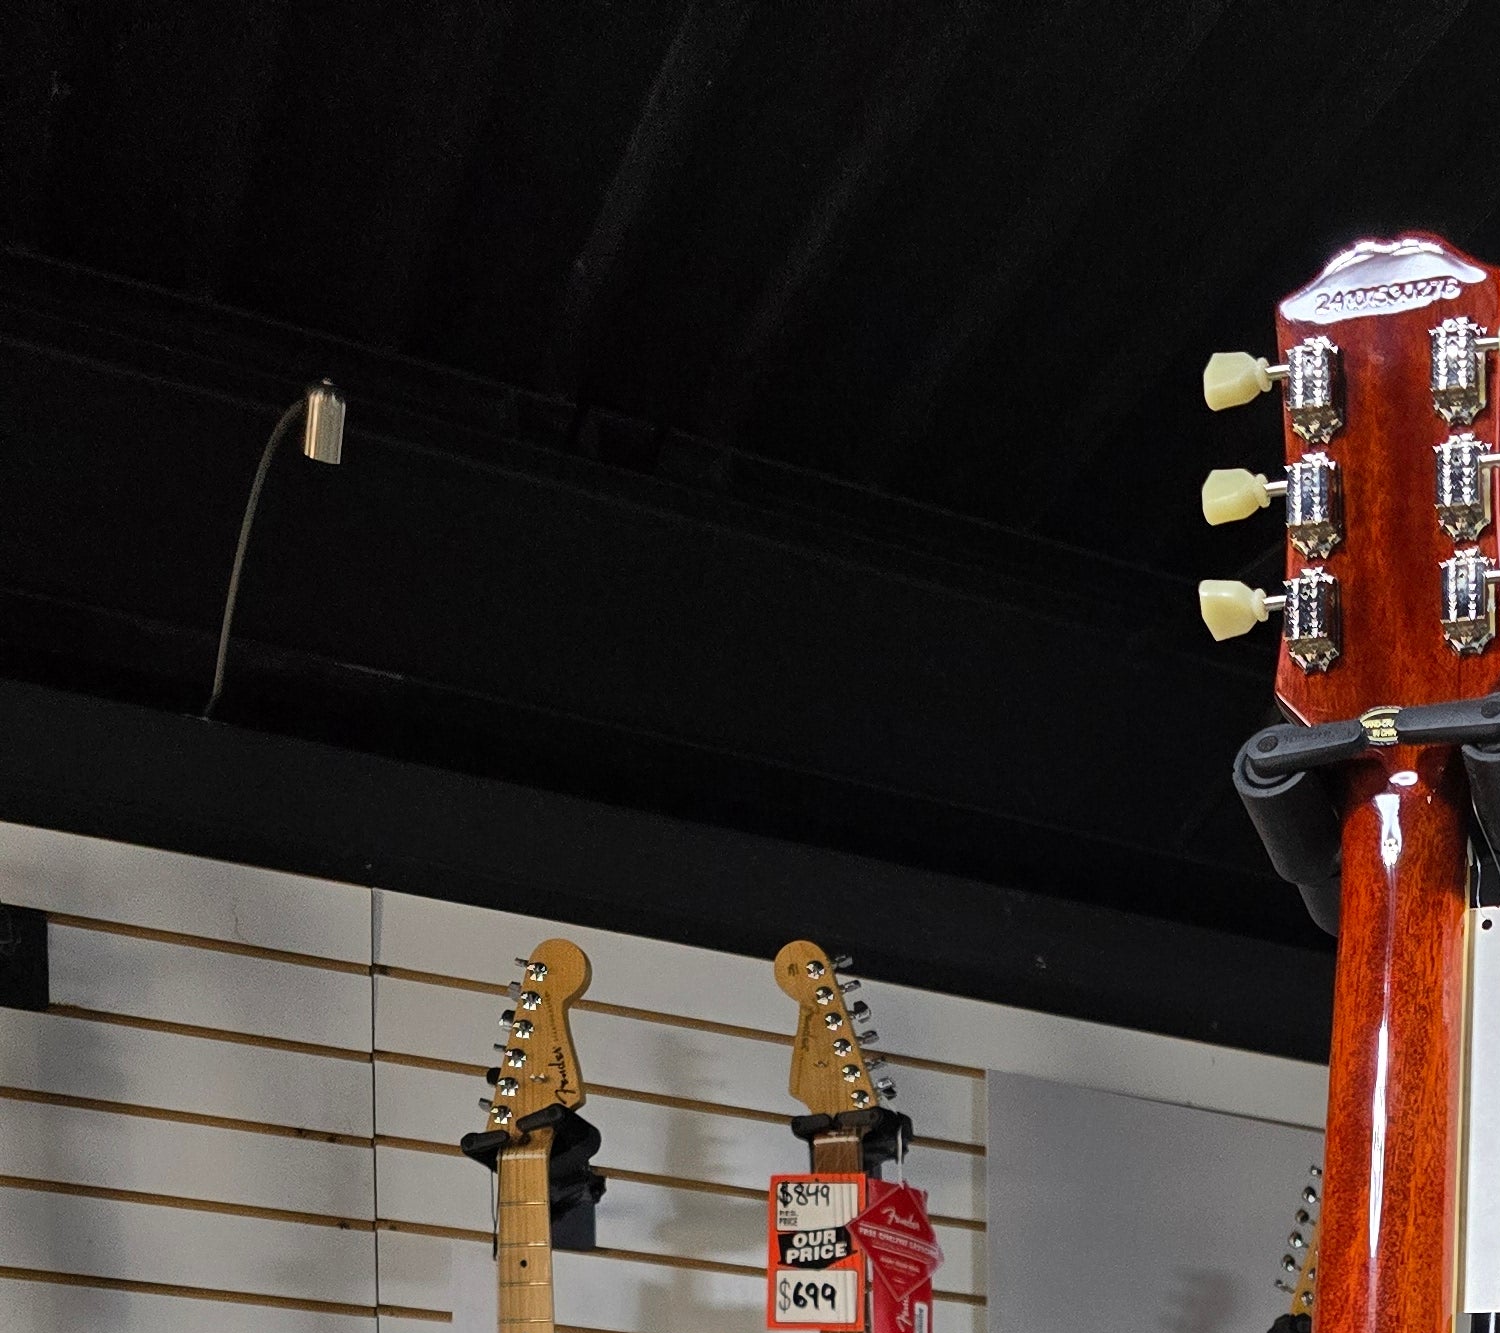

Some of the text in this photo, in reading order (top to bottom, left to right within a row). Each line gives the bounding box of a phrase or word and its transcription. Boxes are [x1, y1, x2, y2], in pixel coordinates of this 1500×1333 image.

[548, 1046, 576, 1104] Fender
[792, 1229, 837, 1248] OUR
[785, 1242, 848, 1265] PRICE
[778, 1278, 837, 1313] $699
